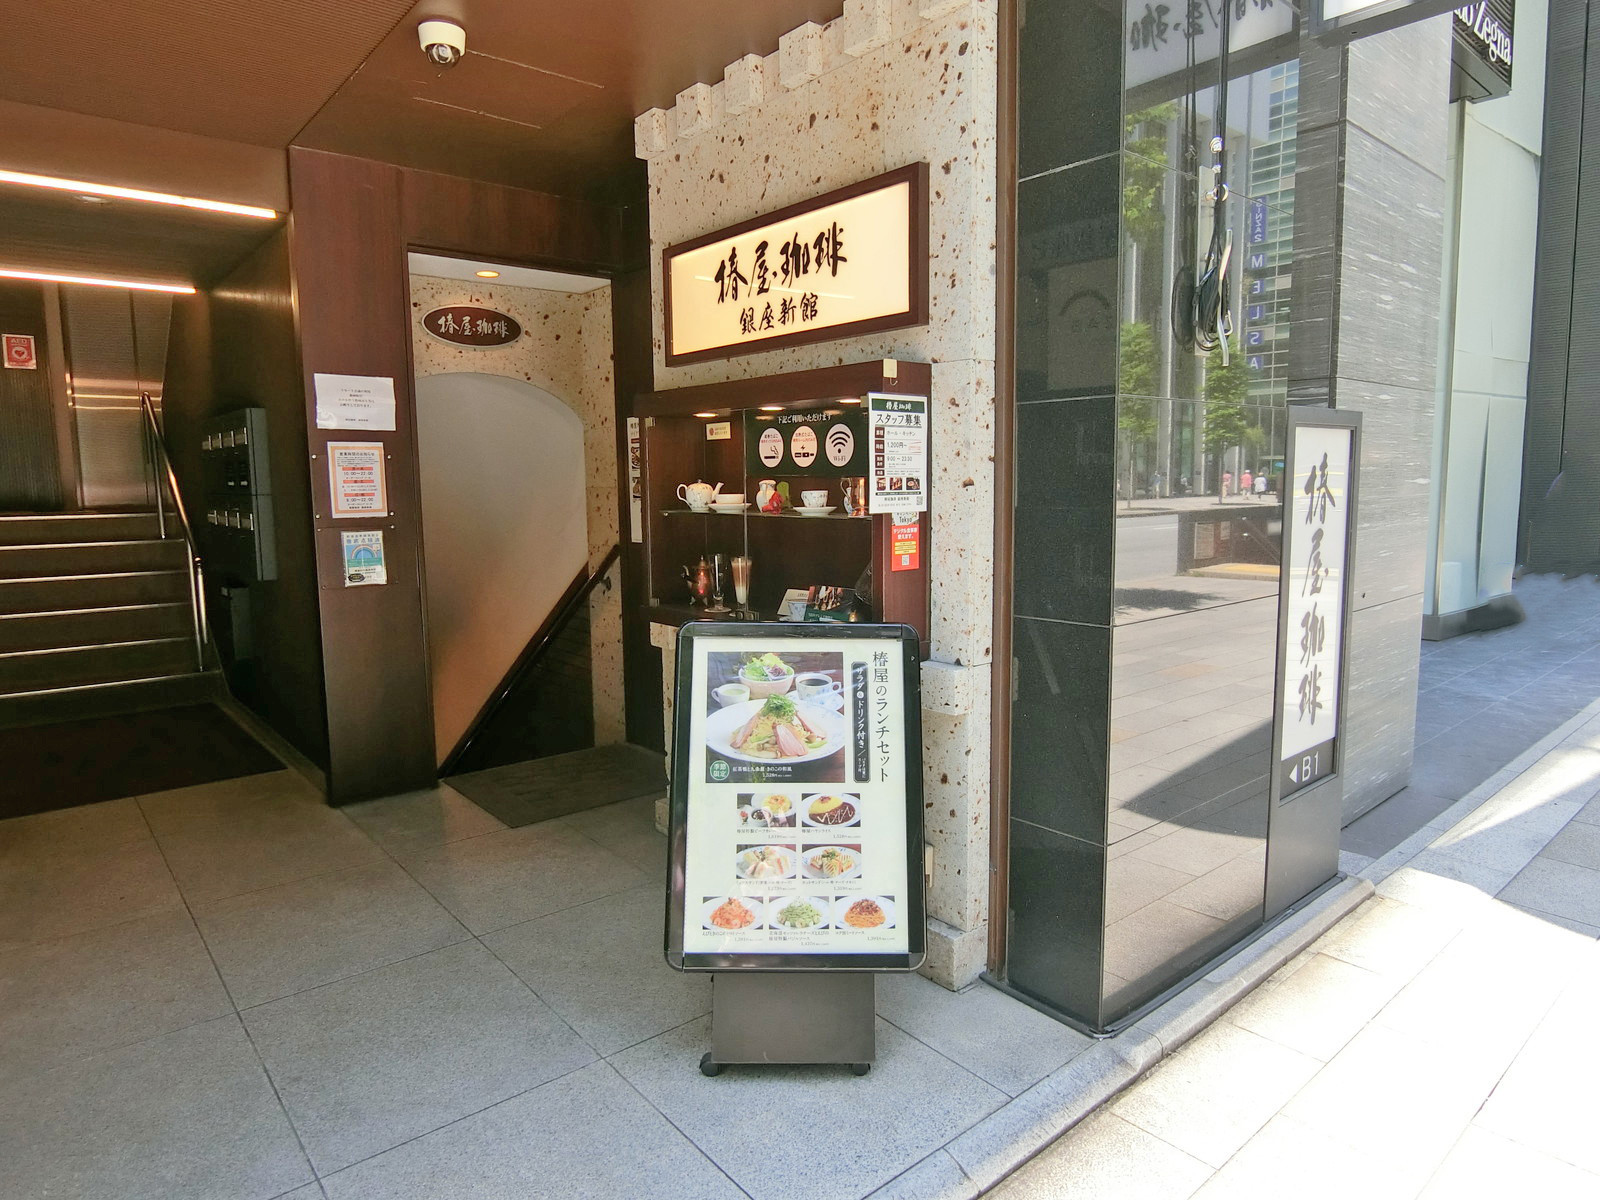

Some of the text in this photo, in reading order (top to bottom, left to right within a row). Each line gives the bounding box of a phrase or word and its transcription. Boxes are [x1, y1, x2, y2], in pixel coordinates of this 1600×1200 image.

[1474, 1, 1511, 66] Zegna
[714, 221, 848, 304] 椿屋珈琲
[437, 312, 510, 338] 椿屋珈琲
[740, 292, 818, 334] 銀座新館
[776, 412, 832, 424] 下記ご利用いただけます
[876, 413, 922, 426] スタッフ募集
[1297, 451, 1336, 726] 椿屋珈琲
[872, 651, 890, 782] 椿屋のランチセット
[1302, 752, 1320, 782] B1
